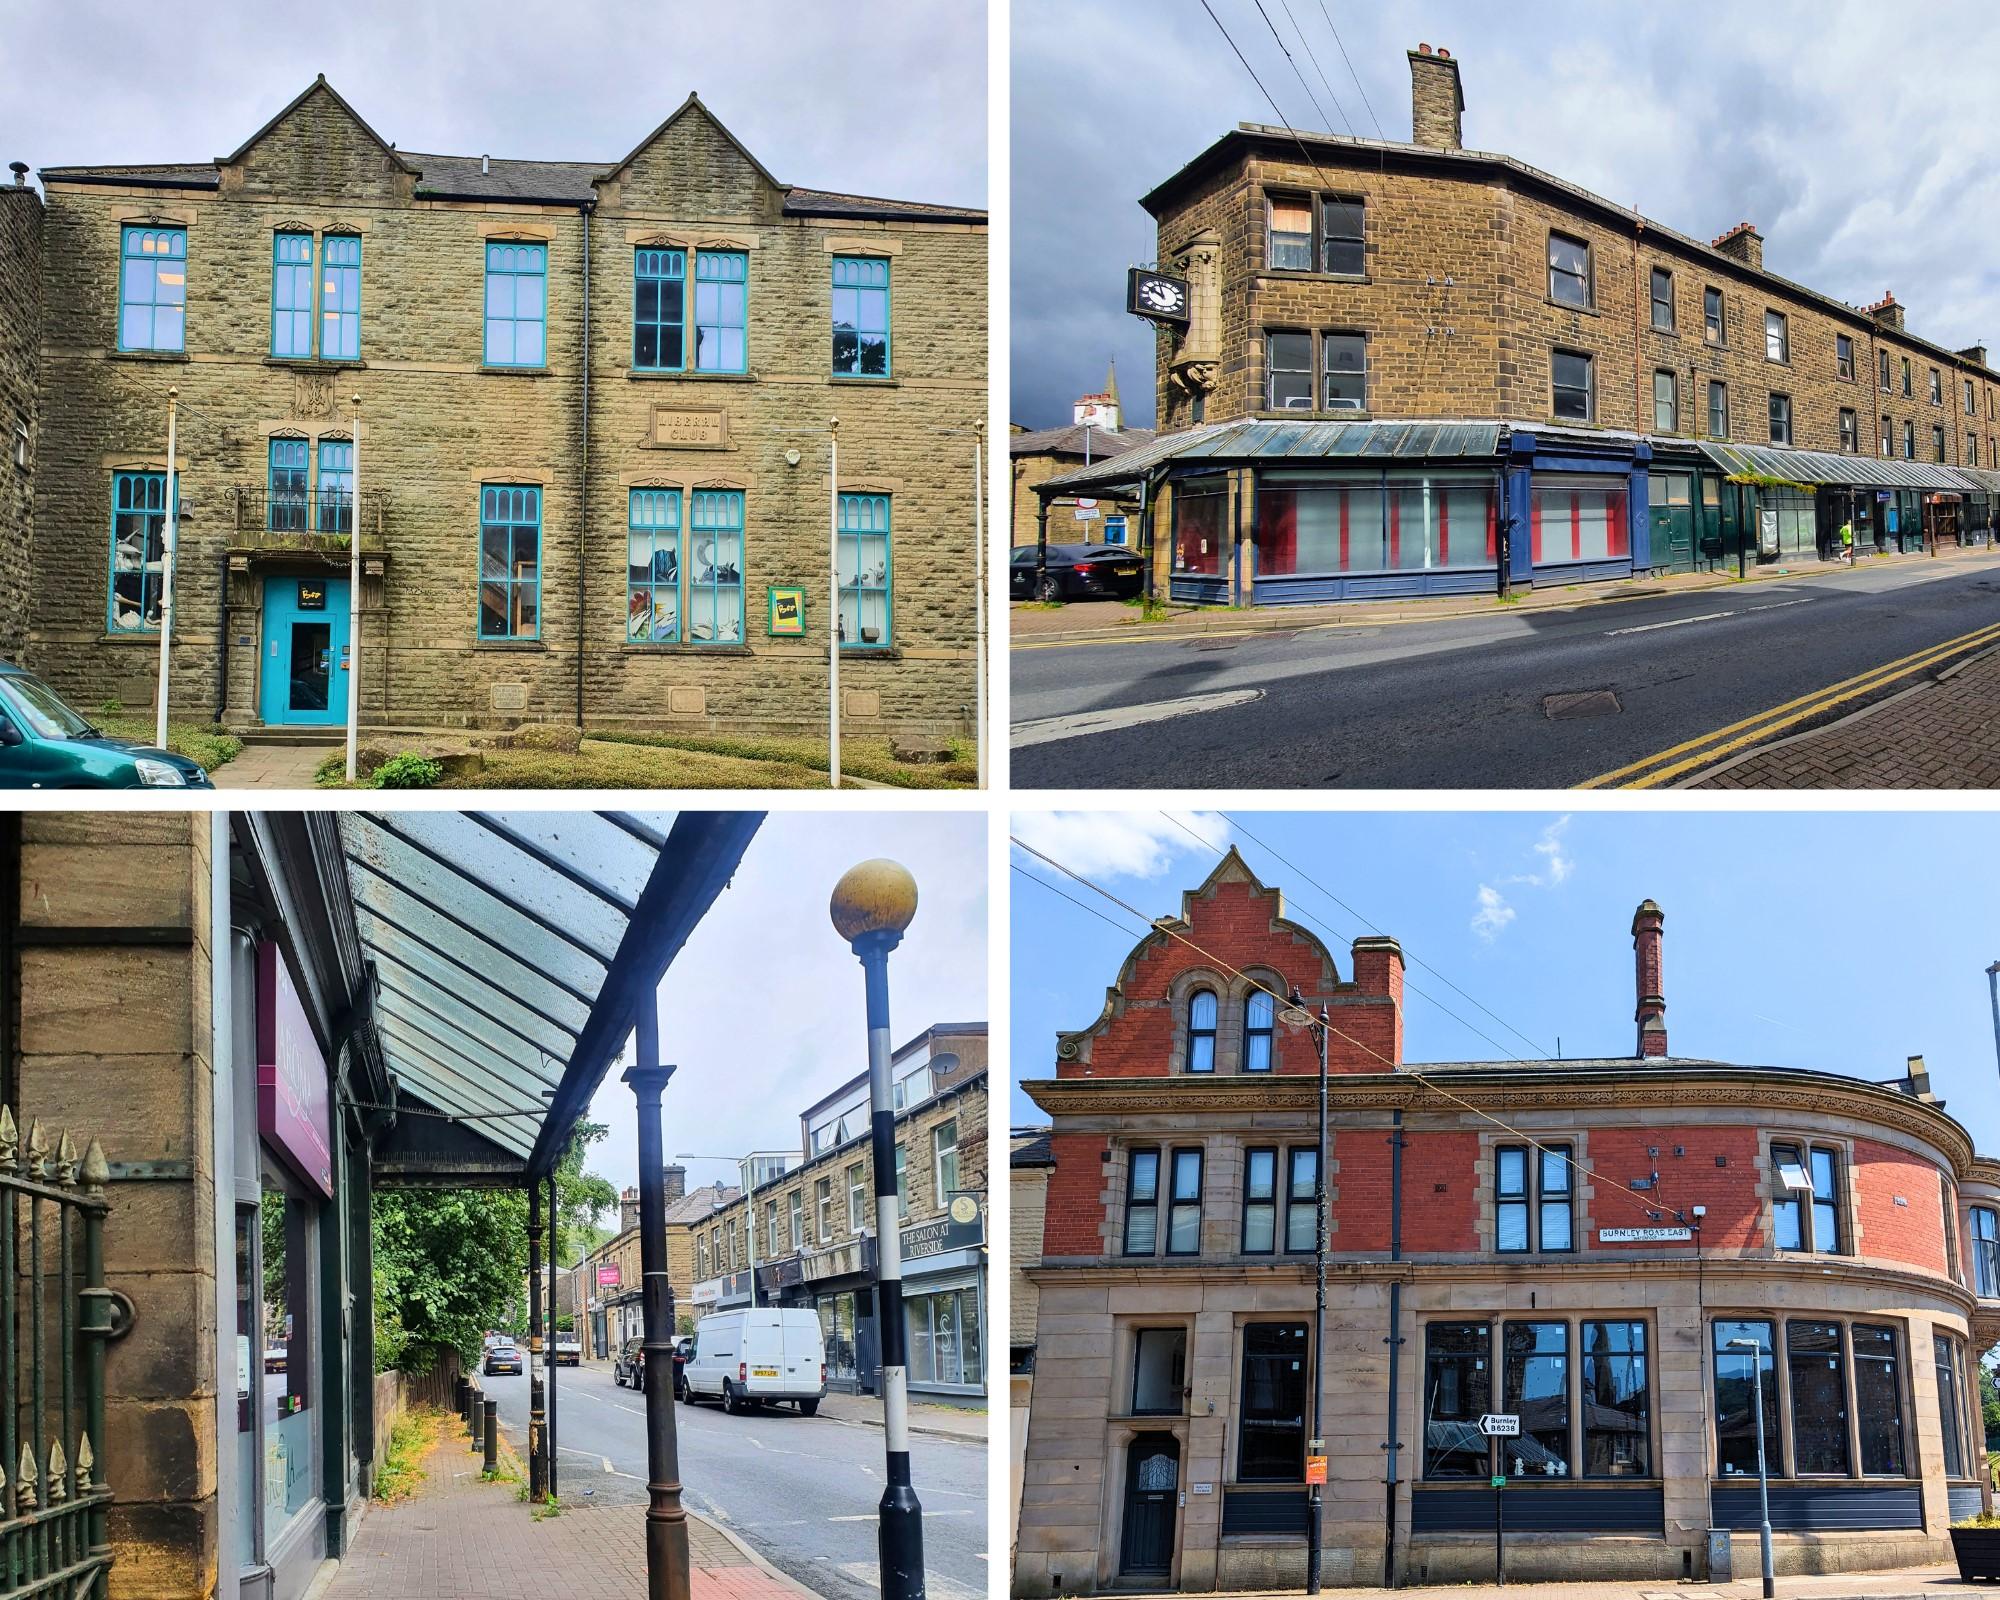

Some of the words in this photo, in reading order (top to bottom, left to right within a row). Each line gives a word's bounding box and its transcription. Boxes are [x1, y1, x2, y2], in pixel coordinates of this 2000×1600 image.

[658, 415, 720, 428] LIBERAL
[671, 429, 708, 441] CLUB
[902, 1229, 916, 1246] THE
[915, 1225, 939, 1243] SALON
[939, 1223, 949, 1237] AT
[1602, 1229, 1641, 1237] BURNLEY
[1667, 1228, 1687, 1236] EAST
[909, 1239, 944, 1257] RIVERSIDE
[1490, 1417, 1517, 1425] Burnley
